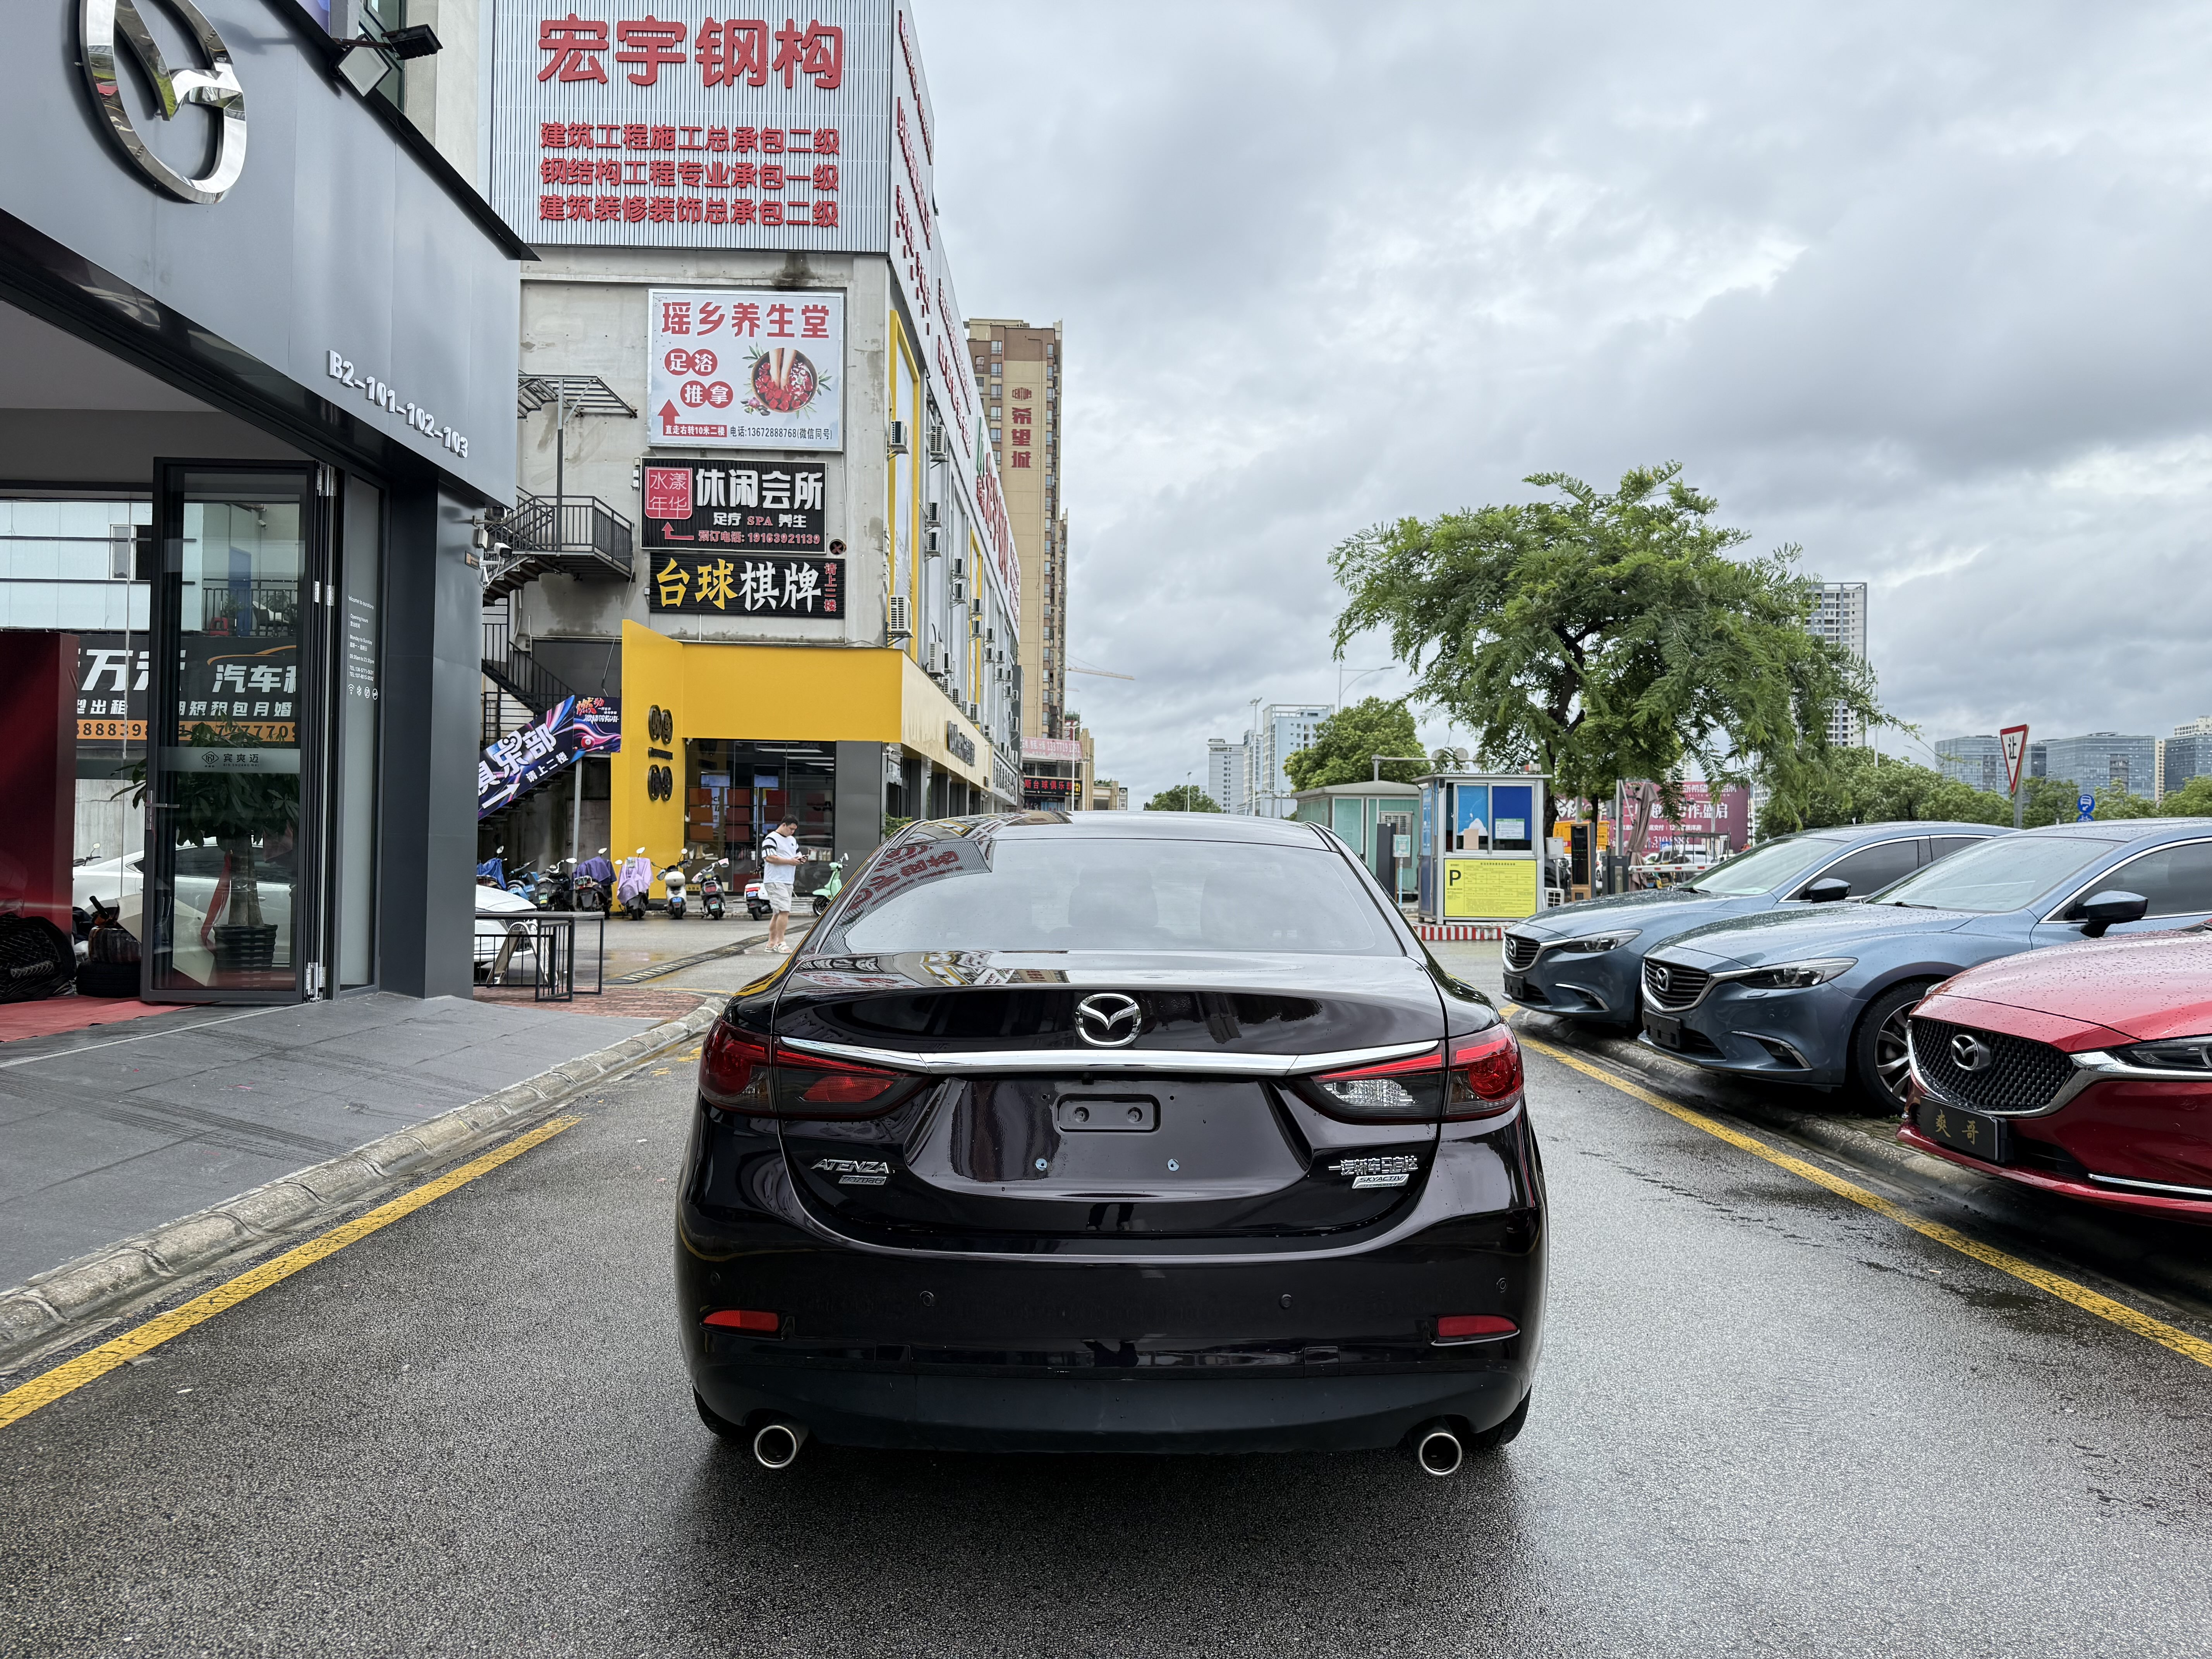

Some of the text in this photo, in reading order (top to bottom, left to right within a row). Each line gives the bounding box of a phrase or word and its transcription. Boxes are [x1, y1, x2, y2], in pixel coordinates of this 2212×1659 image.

[537, 13, 843, 89] 宏宇钢构
[541, 122, 840, 155] 建筑工程施工总承包二级
[540, 157, 839, 191] 钢结构工程专业承包一级
[539, 194, 839, 228] 建筑装修装饰总承包二级
[662, 301, 829, 338] 瑶乡养生堂
[670, 352, 713, 373] 足浴
[328, 350, 468, 457] B2-101-102-103
[684, 385, 729, 404] 推拿
[665, 425, 725, 436] 直走右转10米二楼
[696, 469, 823, 510] 休闲会所
[713, 512, 806, 528] 足疗 SPA 养生
[747, 532, 820, 544] 19163921139
[656, 557, 821, 613] 台球棋牌
[824, 563, 838, 612] 请上二楼
[223, 753, 259, 763] 宾爽迈
[2008, 736, 2017, 760] 让
[1449, 869, 1462, 886] P
[810, 1159, 889, 1174] ATENZA
[1328, 1155, 1418, 1176] 一汽轿车马自达
